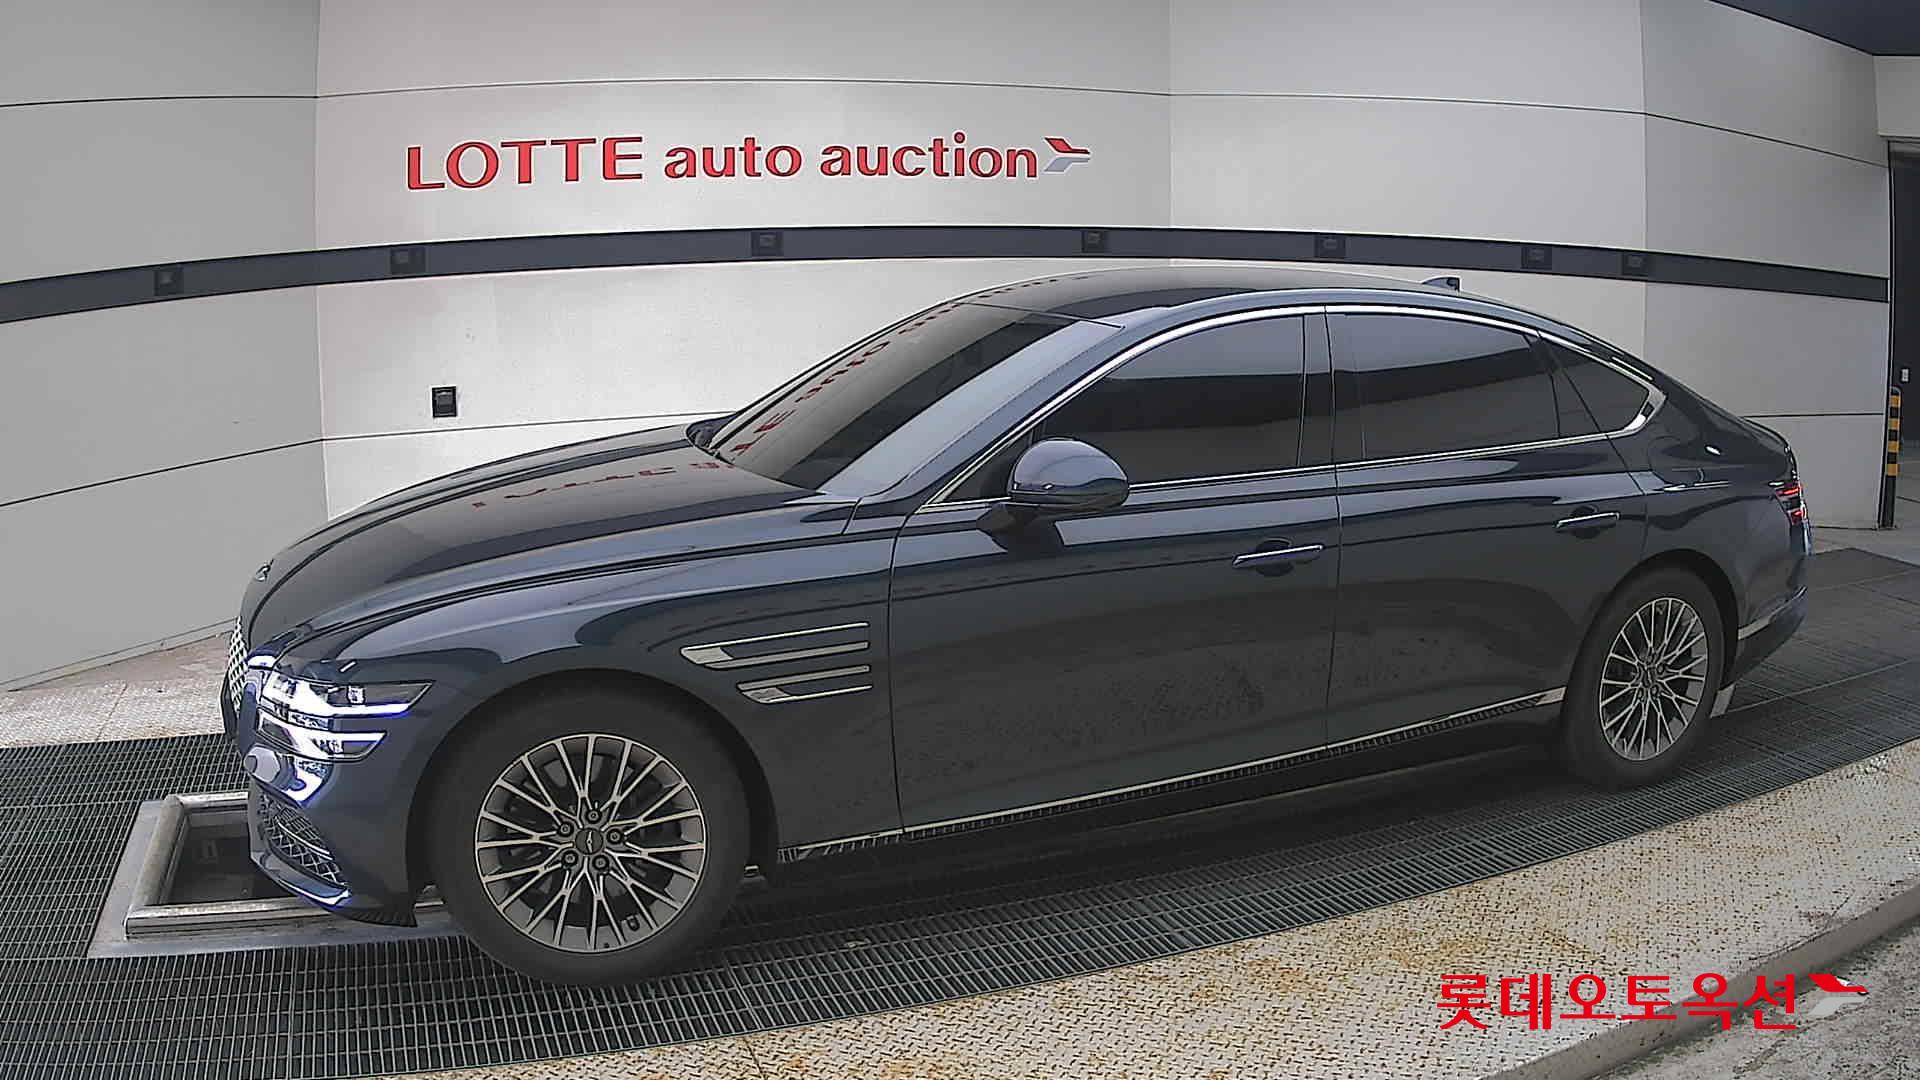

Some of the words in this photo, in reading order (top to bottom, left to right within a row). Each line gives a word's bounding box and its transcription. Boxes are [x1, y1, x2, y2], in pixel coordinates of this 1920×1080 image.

[407, 136, 643, 190] LOTTE
[664, 136, 803, 178] auto
[820, 132, 1038, 178] auction
